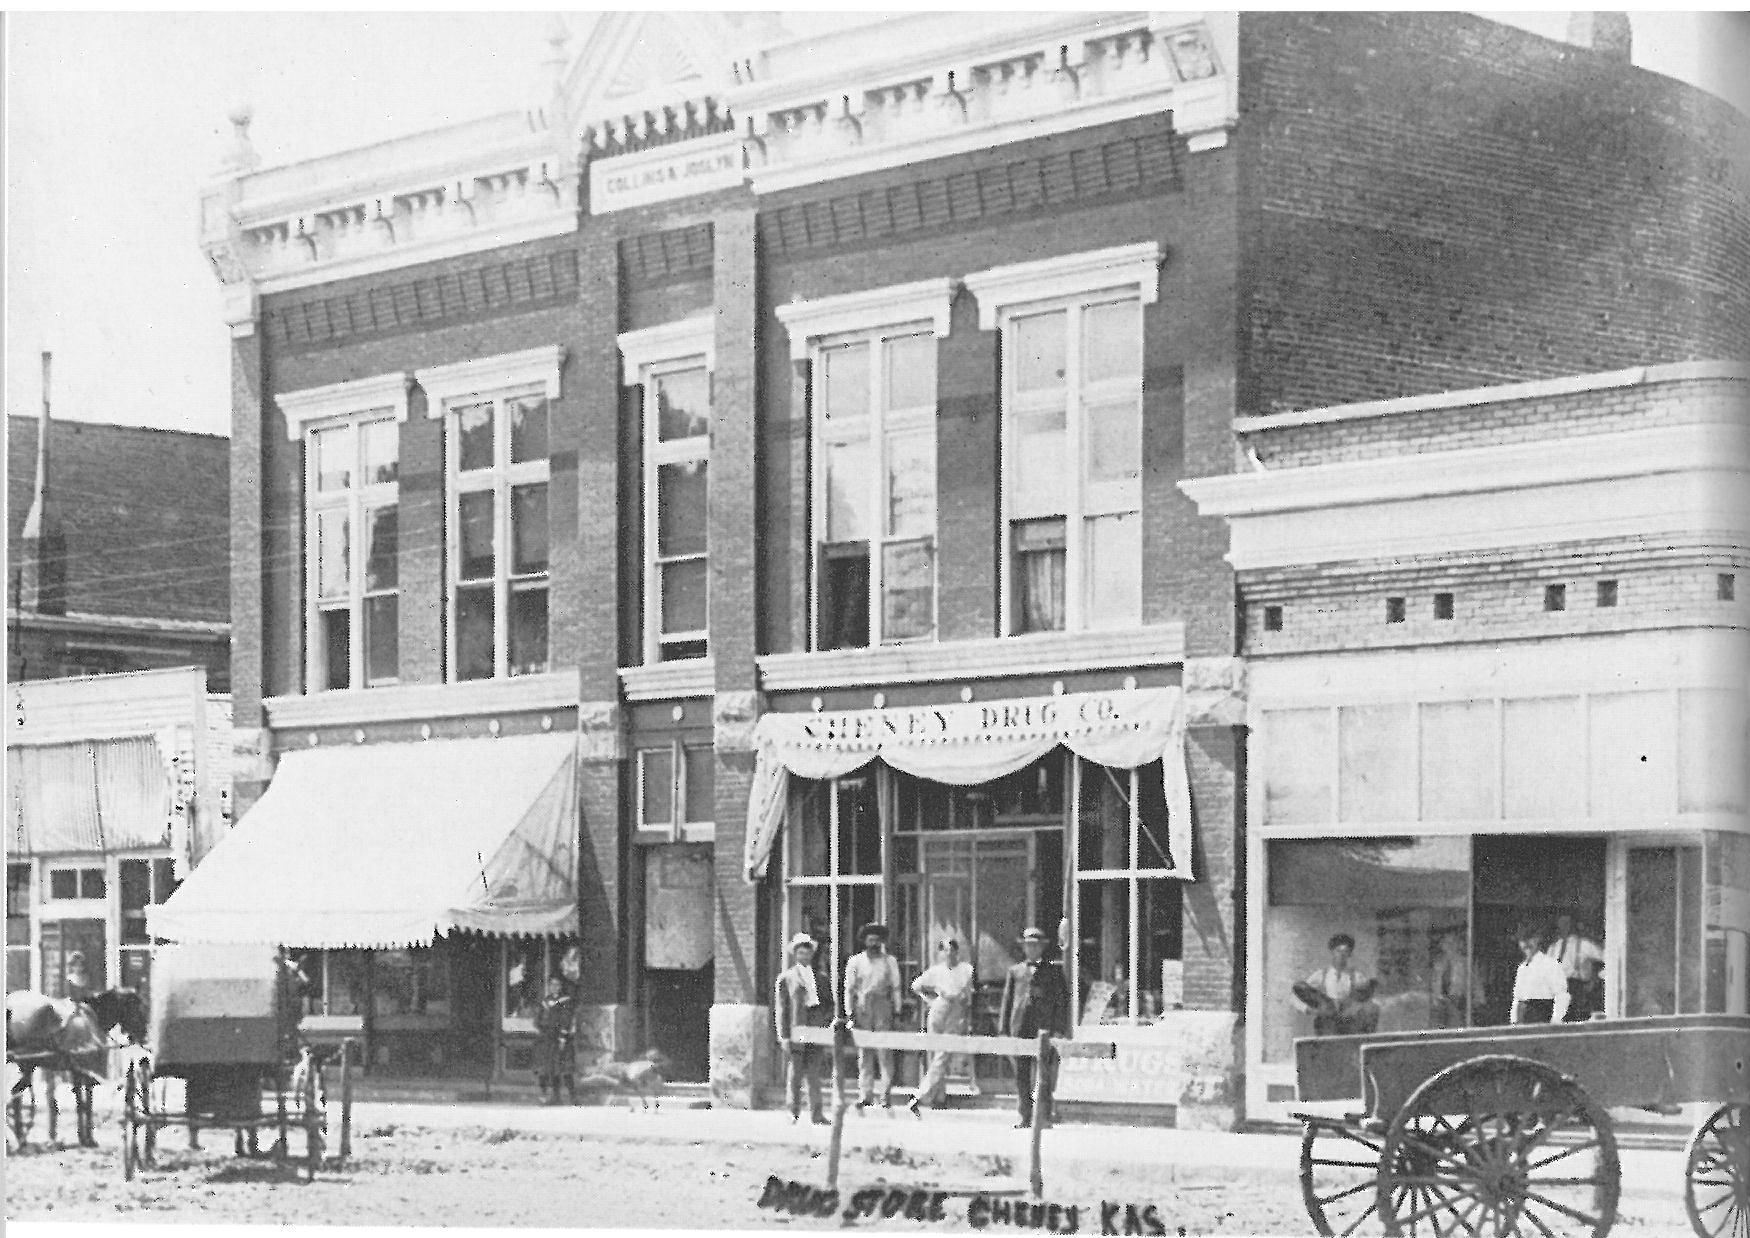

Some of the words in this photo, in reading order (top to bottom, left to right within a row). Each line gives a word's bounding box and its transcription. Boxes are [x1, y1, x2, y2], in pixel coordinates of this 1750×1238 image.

[803, 711, 954, 739] CHENEY
[981, 701, 1055, 728] DRUG
[1079, 698, 1119, 722] CO.
